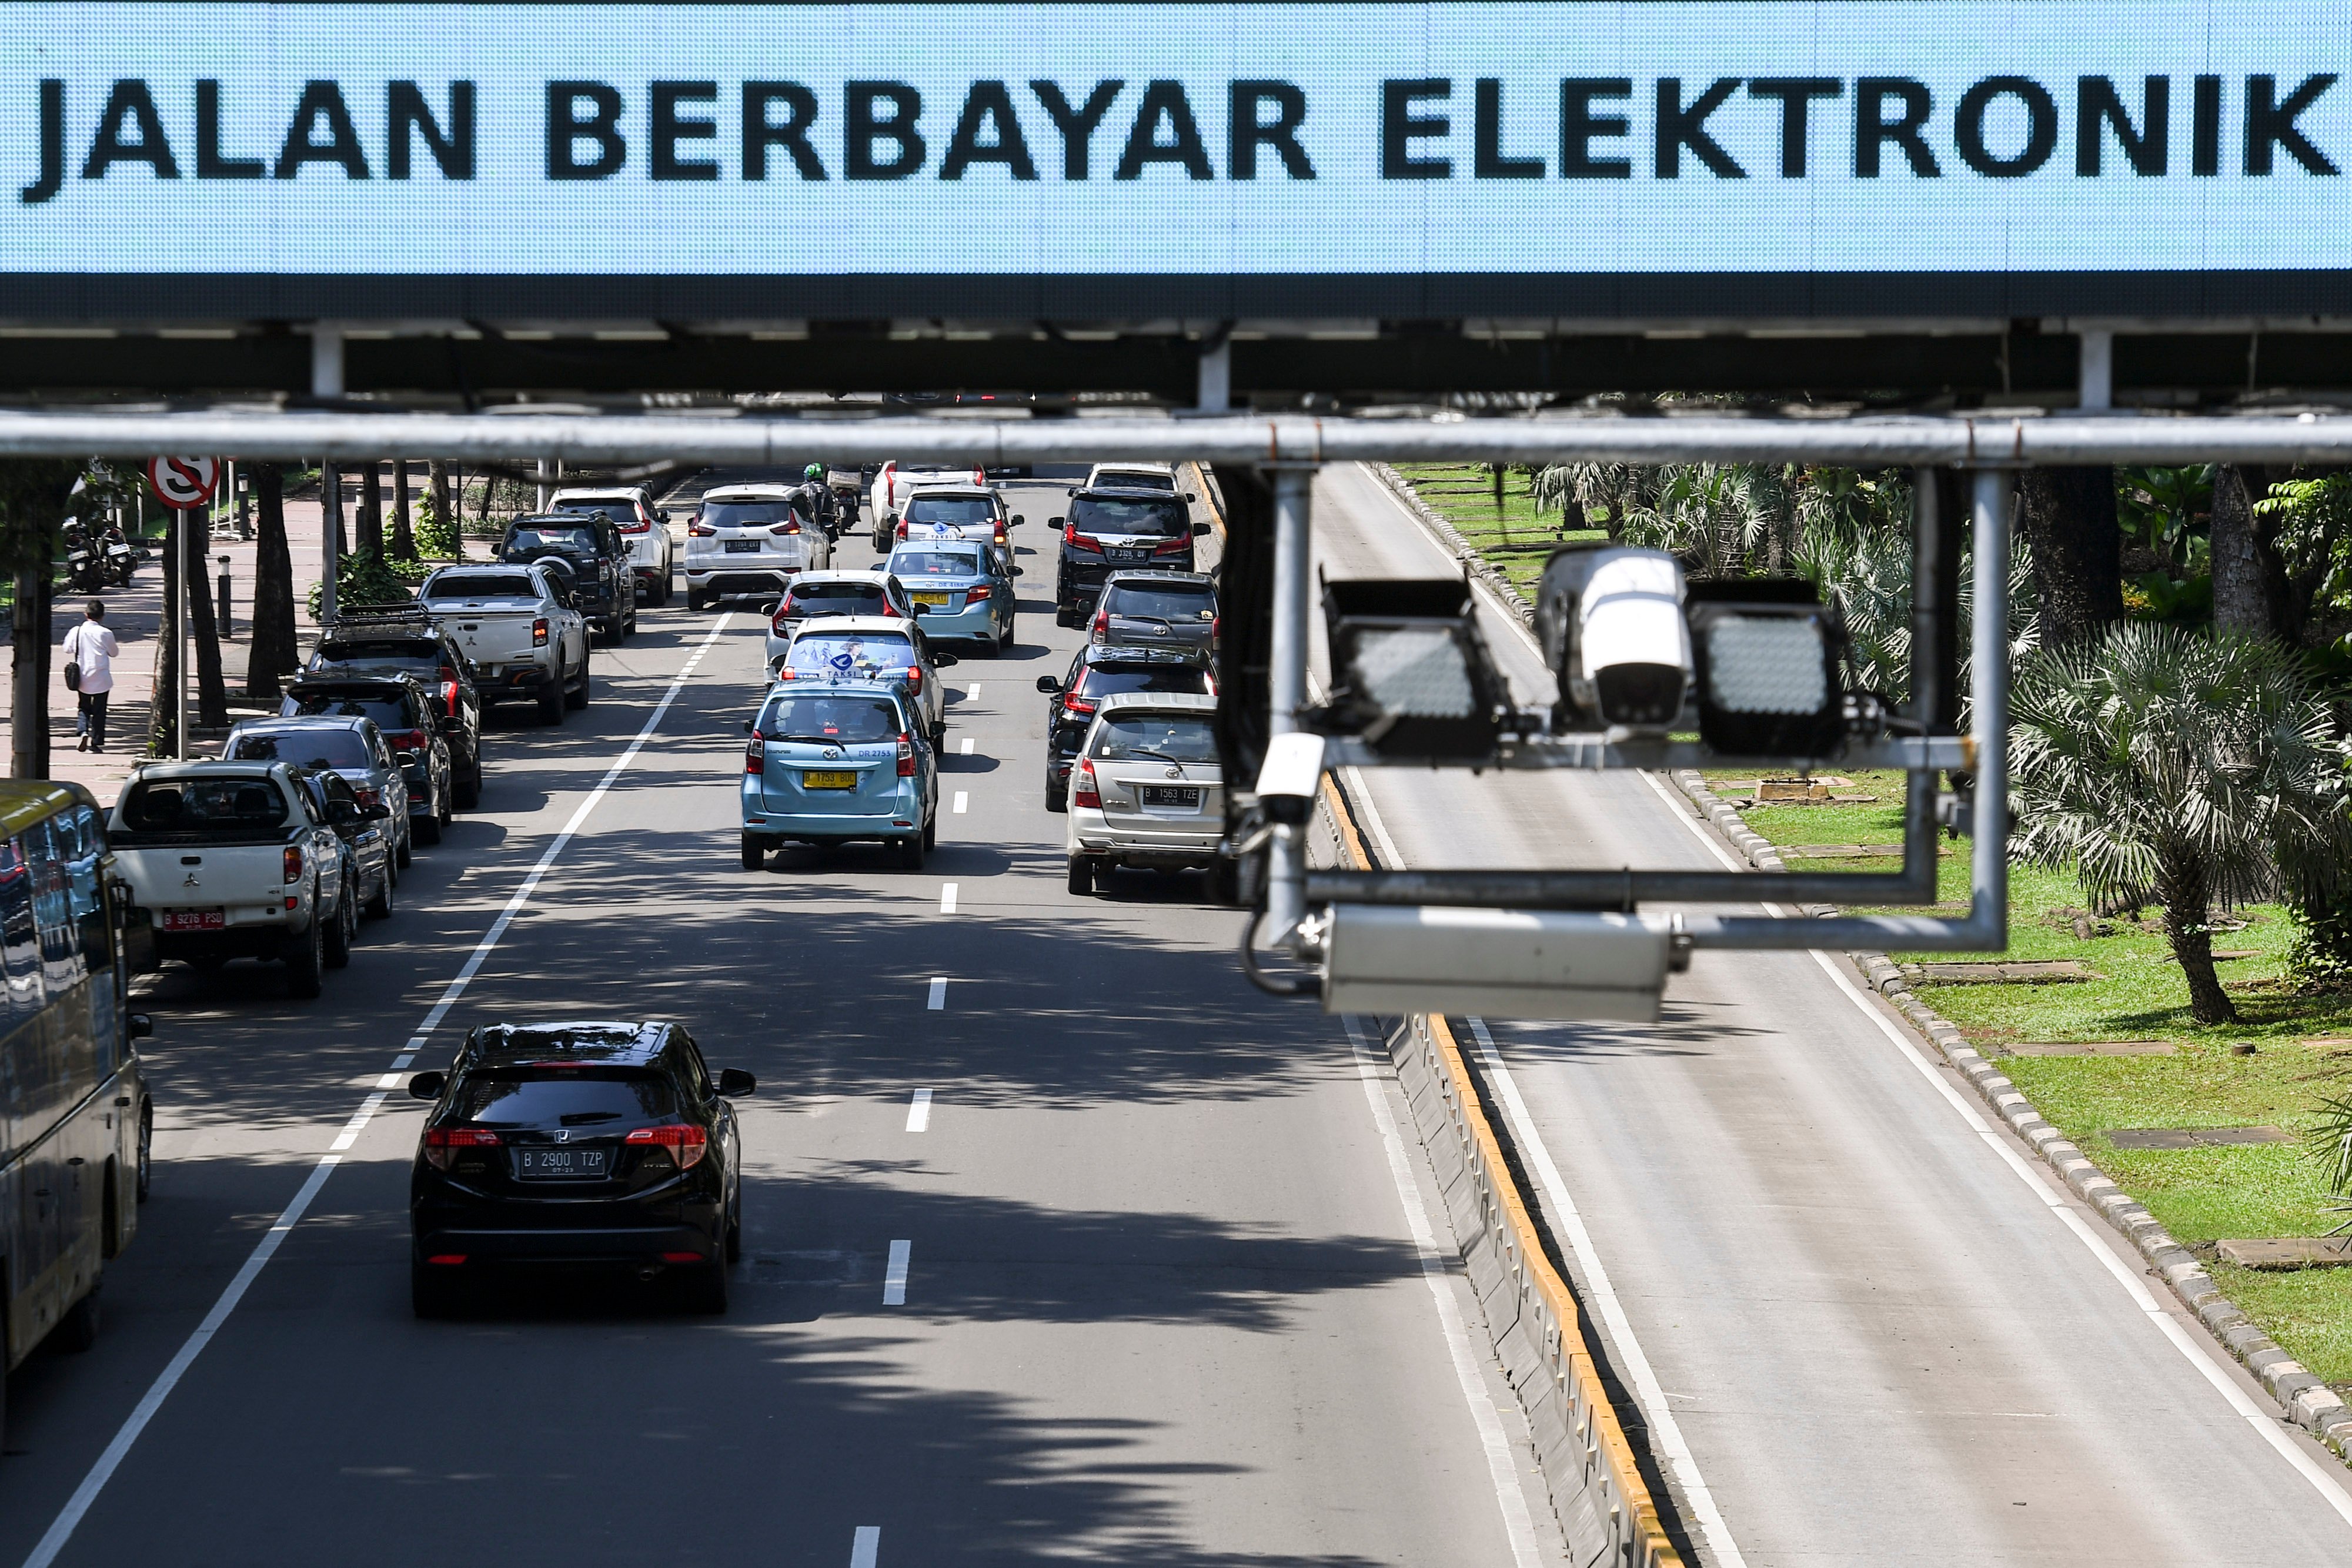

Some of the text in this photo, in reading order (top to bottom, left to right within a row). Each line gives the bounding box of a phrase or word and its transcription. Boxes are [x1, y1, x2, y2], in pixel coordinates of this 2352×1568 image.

[22, 74, 2340, 204] JALAN BERBAYAR ELEKTRONIK
[805, 773, 854, 782] B 1753 BUC
[1145, 788, 1197, 799] B 1563 TZE
[165, 912, 222, 925] B 9276 PSD
[524, 1152, 603, 1167] B 2900 TZP
